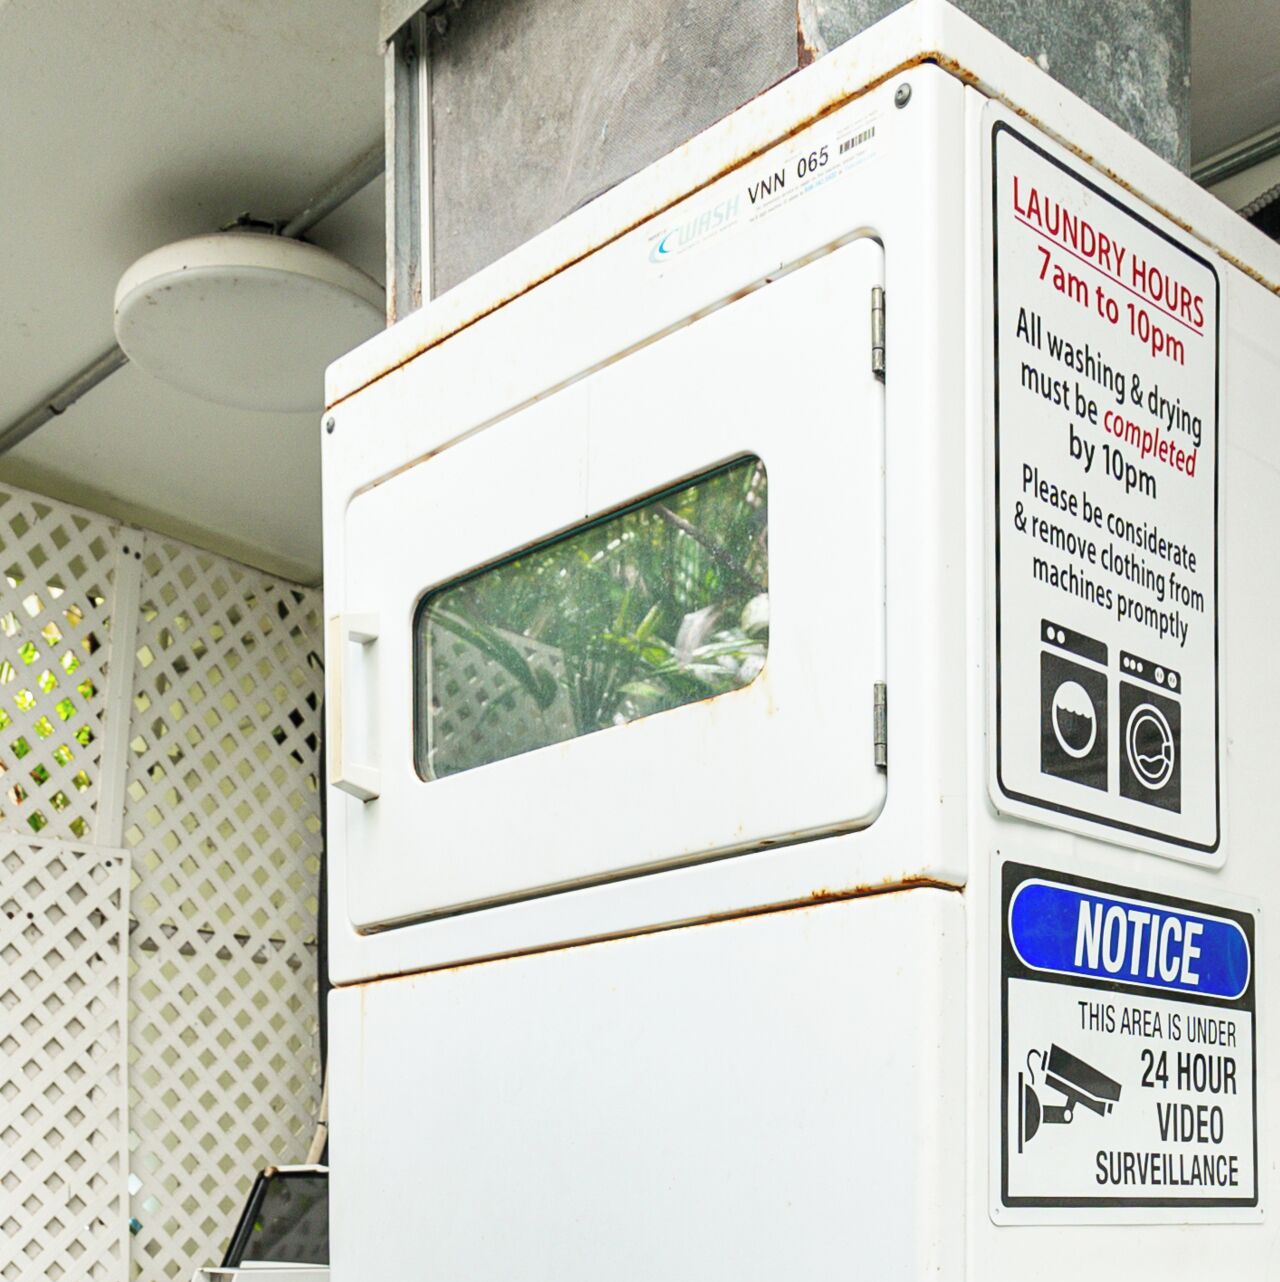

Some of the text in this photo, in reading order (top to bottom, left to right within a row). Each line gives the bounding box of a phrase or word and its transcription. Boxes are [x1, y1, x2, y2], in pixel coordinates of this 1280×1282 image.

[748, 168, 785, 204] VNN
[797, 145, 829, 178] 065
[678, 193, 740, 245] WASH
[1014, 176, 1204, 327] LAUNDRY HOURS
[1038, 245, 1185, 365] 7am to 10pm
[1016, 307, 1202, 447] All washing & drying
[1021, 362, 1197, 478] must be completed
[1070, 423, 1157, 499] by 10pm
[1014, 501, 1204, 613] & remove clothing from
[1023, 463, 1196, 573] Please be considerate
[1033, 556, 1189, 648] machines promptly
[1074, 900, 1204, 985] NOTICE
[1078, 1001, 1237, 1048] THIS AREA IS UNDER
[1141, 1049, 1237, 1095] 24 HOUR
[1157, 1103, 1224, 1144] VIDEO
[1096, 1151, 1239, 1187] SURVEILLANCE
